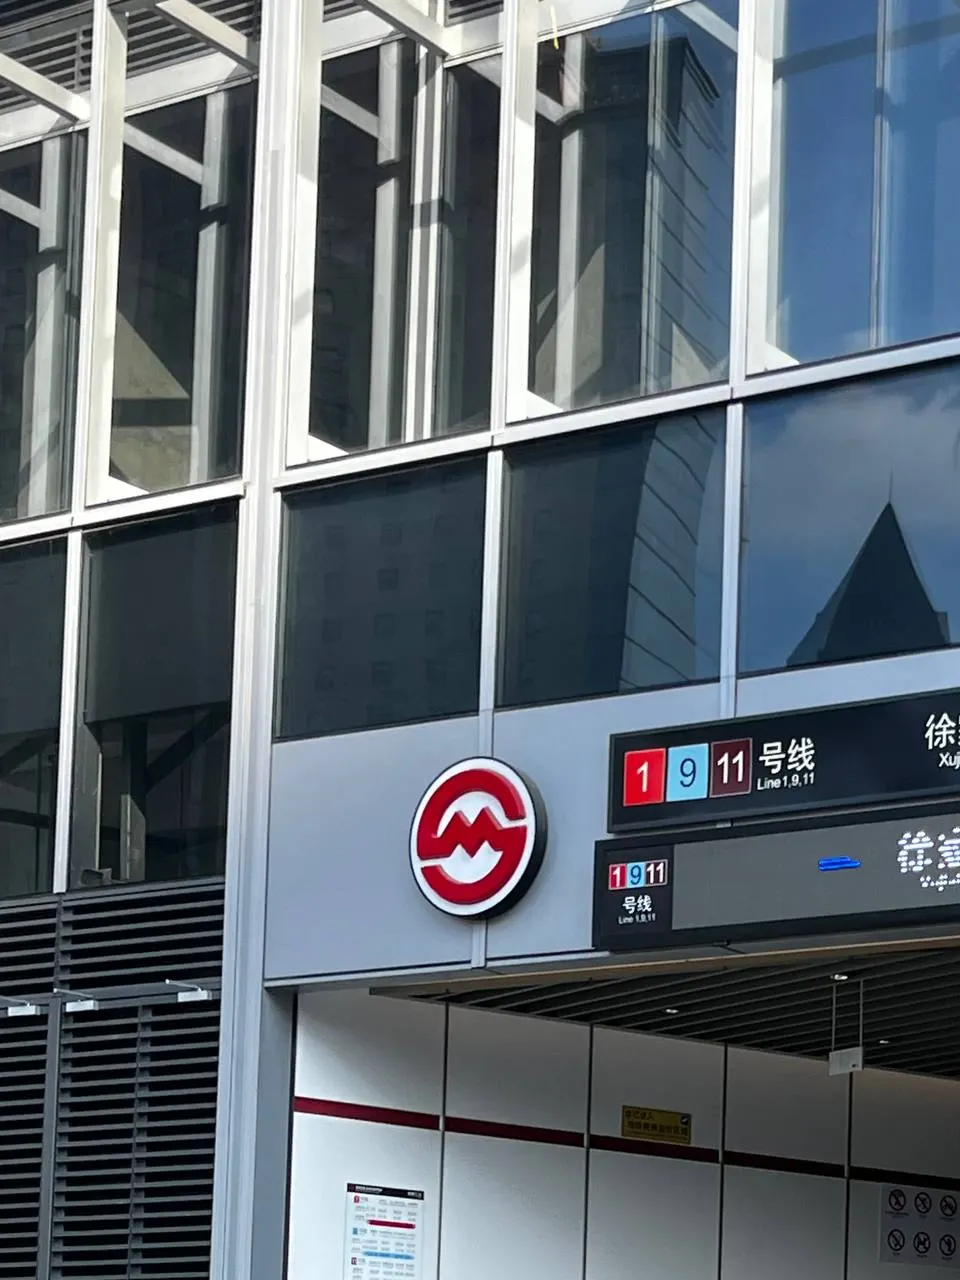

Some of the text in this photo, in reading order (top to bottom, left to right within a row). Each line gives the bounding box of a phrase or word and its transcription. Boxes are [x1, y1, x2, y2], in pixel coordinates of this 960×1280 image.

[636, 737, 816, 793] 1 9 11 号线
[757, 775, 781, 790] Line
[612, 862, 664, 887] 1 9 11
[622, 895, 652, 914] 号线
